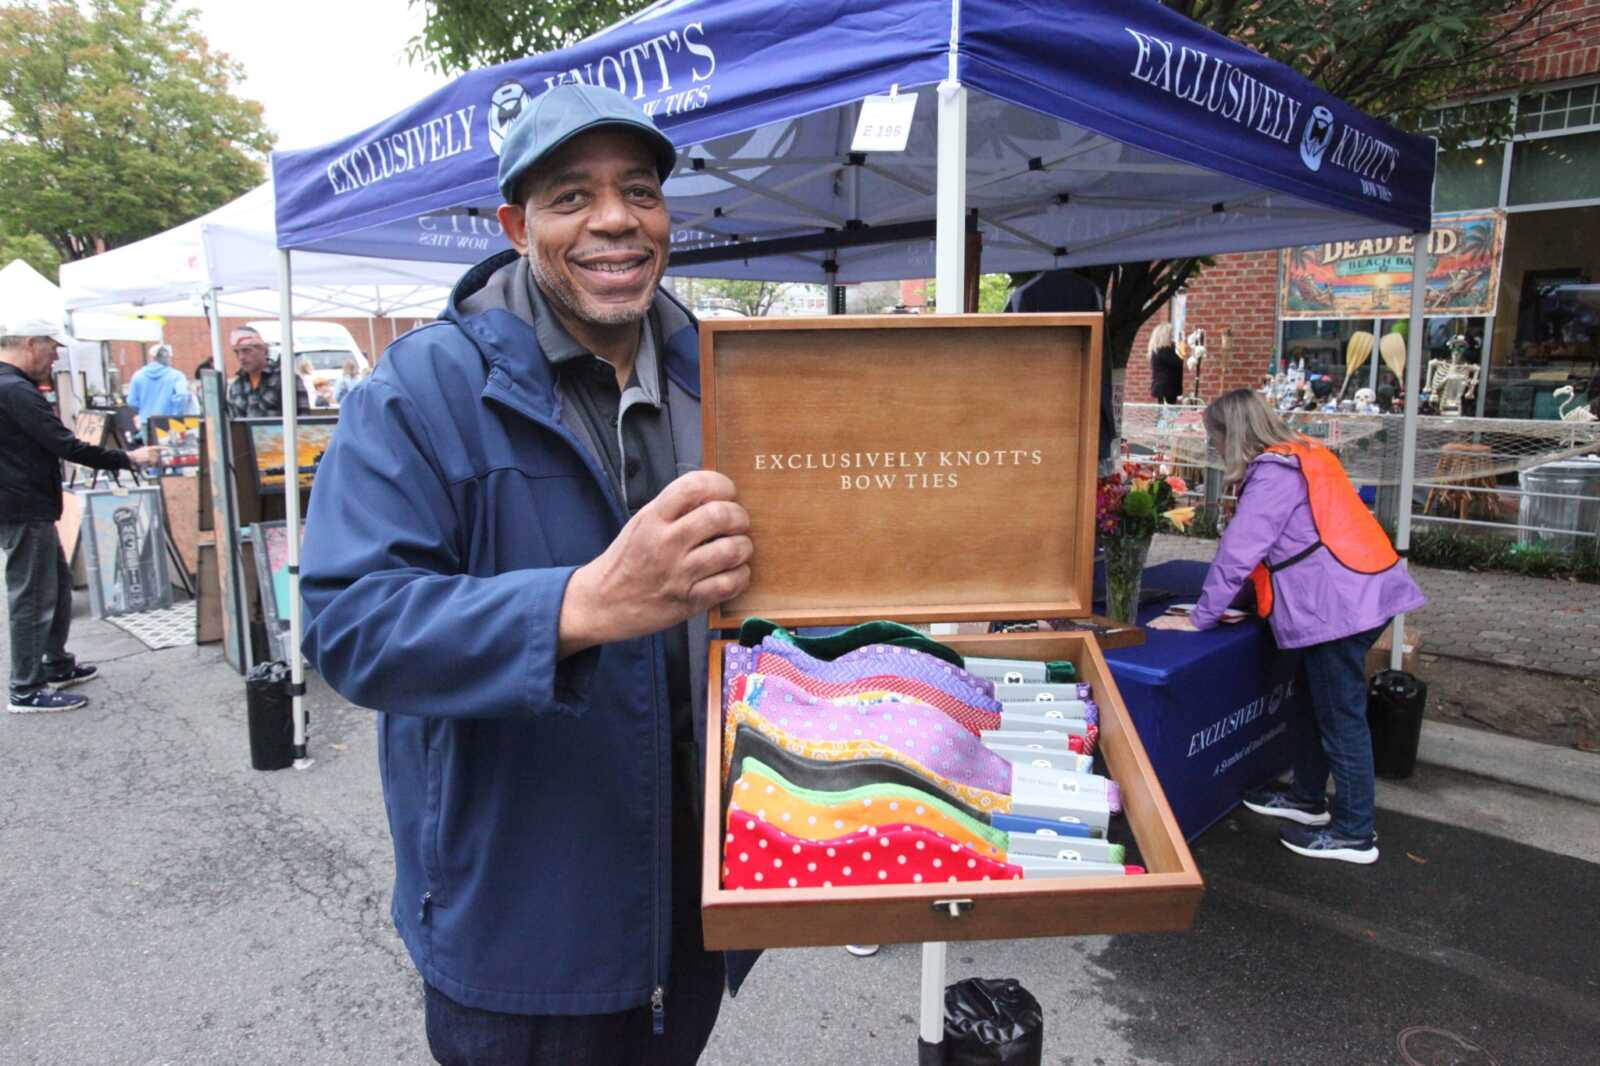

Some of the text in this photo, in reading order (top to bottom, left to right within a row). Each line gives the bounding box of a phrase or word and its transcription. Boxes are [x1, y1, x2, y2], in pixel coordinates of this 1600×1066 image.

[664, 85, 711, 117] TIES
[1125, 27, 1302, 145] EXCLUSIVELY
[327, 104, 476, 195] EXCLUSIVELY
[1321, 237, 1393, 265] DEAD
[1396, 256, 1414, 266] BA
[755, 450, 1043, 470] EXCLUSIVELY KNOTT'S
[840, 473, 959, 490] BOW TIES
[1186, 696, 1264, 758] EXCLUSIVELY
